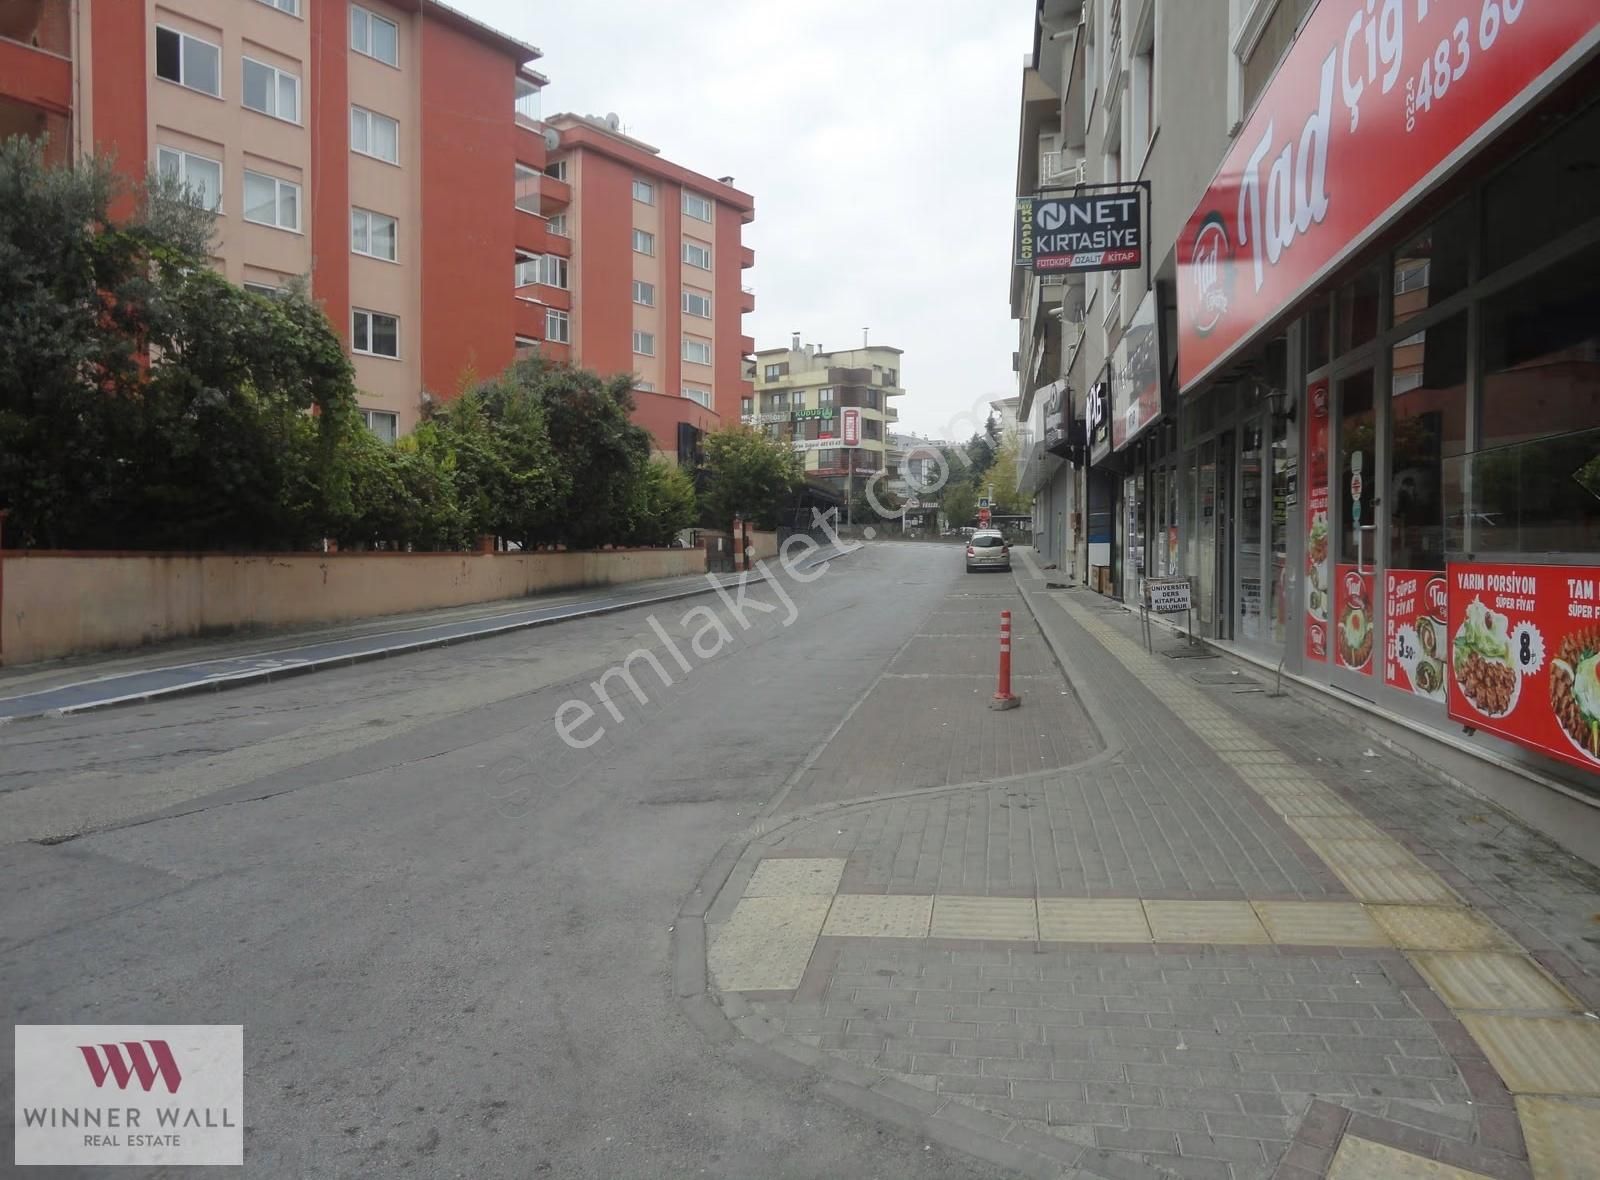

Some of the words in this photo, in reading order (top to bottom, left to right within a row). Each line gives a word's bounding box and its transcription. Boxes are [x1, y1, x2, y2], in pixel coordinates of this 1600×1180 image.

[1416, 16, 1470, 113] 483
[1238, 47, 1337, 294] Tad
[1070, 199, 1137, 226] NET
[1037, 225, 1137, 253] KIRTASİYE
[1108, 250, 1135, 262] KİTAP
[1396, 579, 1417, 598] SÜPER
[1458, 573, 1484, 591] YARIM
[1487, 571, 1536, 594] PORSİYON
[1567, 579, 1593, 599] TAM
[1396, 596, 1415, 616] FİYAT
[1495, 594, 1515, 609] SÜPER
[1516, 596, 1535, 611] FİYAT
[1568, 601, 1593, 618] SÜPER
[1387, 575, 1395, 681] DÜRÜM
